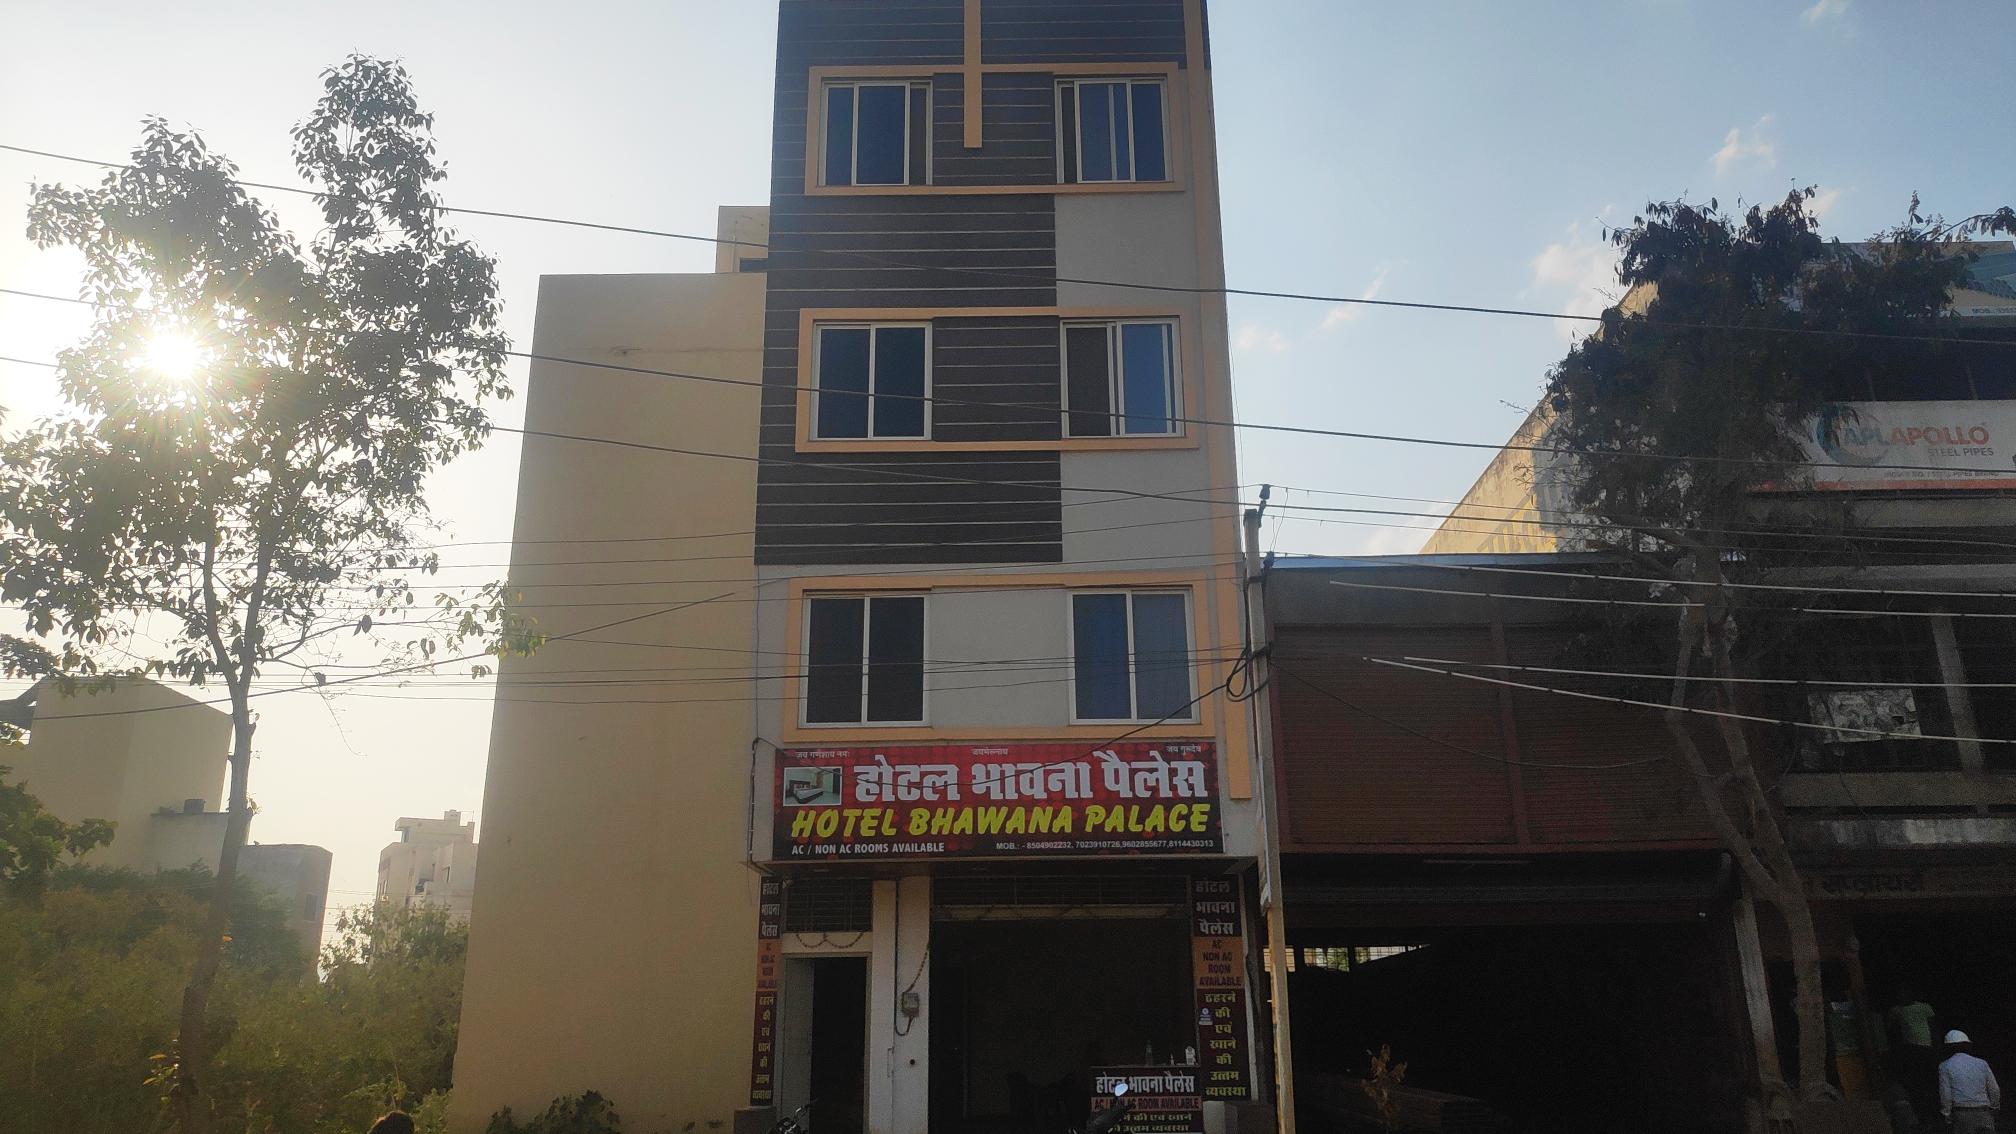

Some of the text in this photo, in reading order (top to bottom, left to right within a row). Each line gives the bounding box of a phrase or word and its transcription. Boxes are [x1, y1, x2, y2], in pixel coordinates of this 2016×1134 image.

[1890, 425, 1990, 446] APOLLO
[1927, 447, 1994, 457] STEEL PIPES
[853, 750, 1208, 802] होटल भावना पैलेस
[791, 804, 1211, 838] HOTEL BHAWANA PALACE
[791, 845, 804, 855] AC
[815, 844, 837, 854] NON
[839, 844, 851, 853] AC
[854, 843, 889, 853] ROOMS
[891, 842, 945, 853] AVAILABLE
[1196, 901, 1235, 914] भावना
[1199, 918, 1233, 935] पैलेस
[1208, 963, 1231, 973] ROOM
[1200, 976, 1242, 986] AVAILABLE
[1214, 1006, 1230, 1018] की
[1215, 1053, 1232, 1065] की
[1129, 1076, 1163, 1093] भावना
[1163, 1070, 1195, 1093] पैलेस
